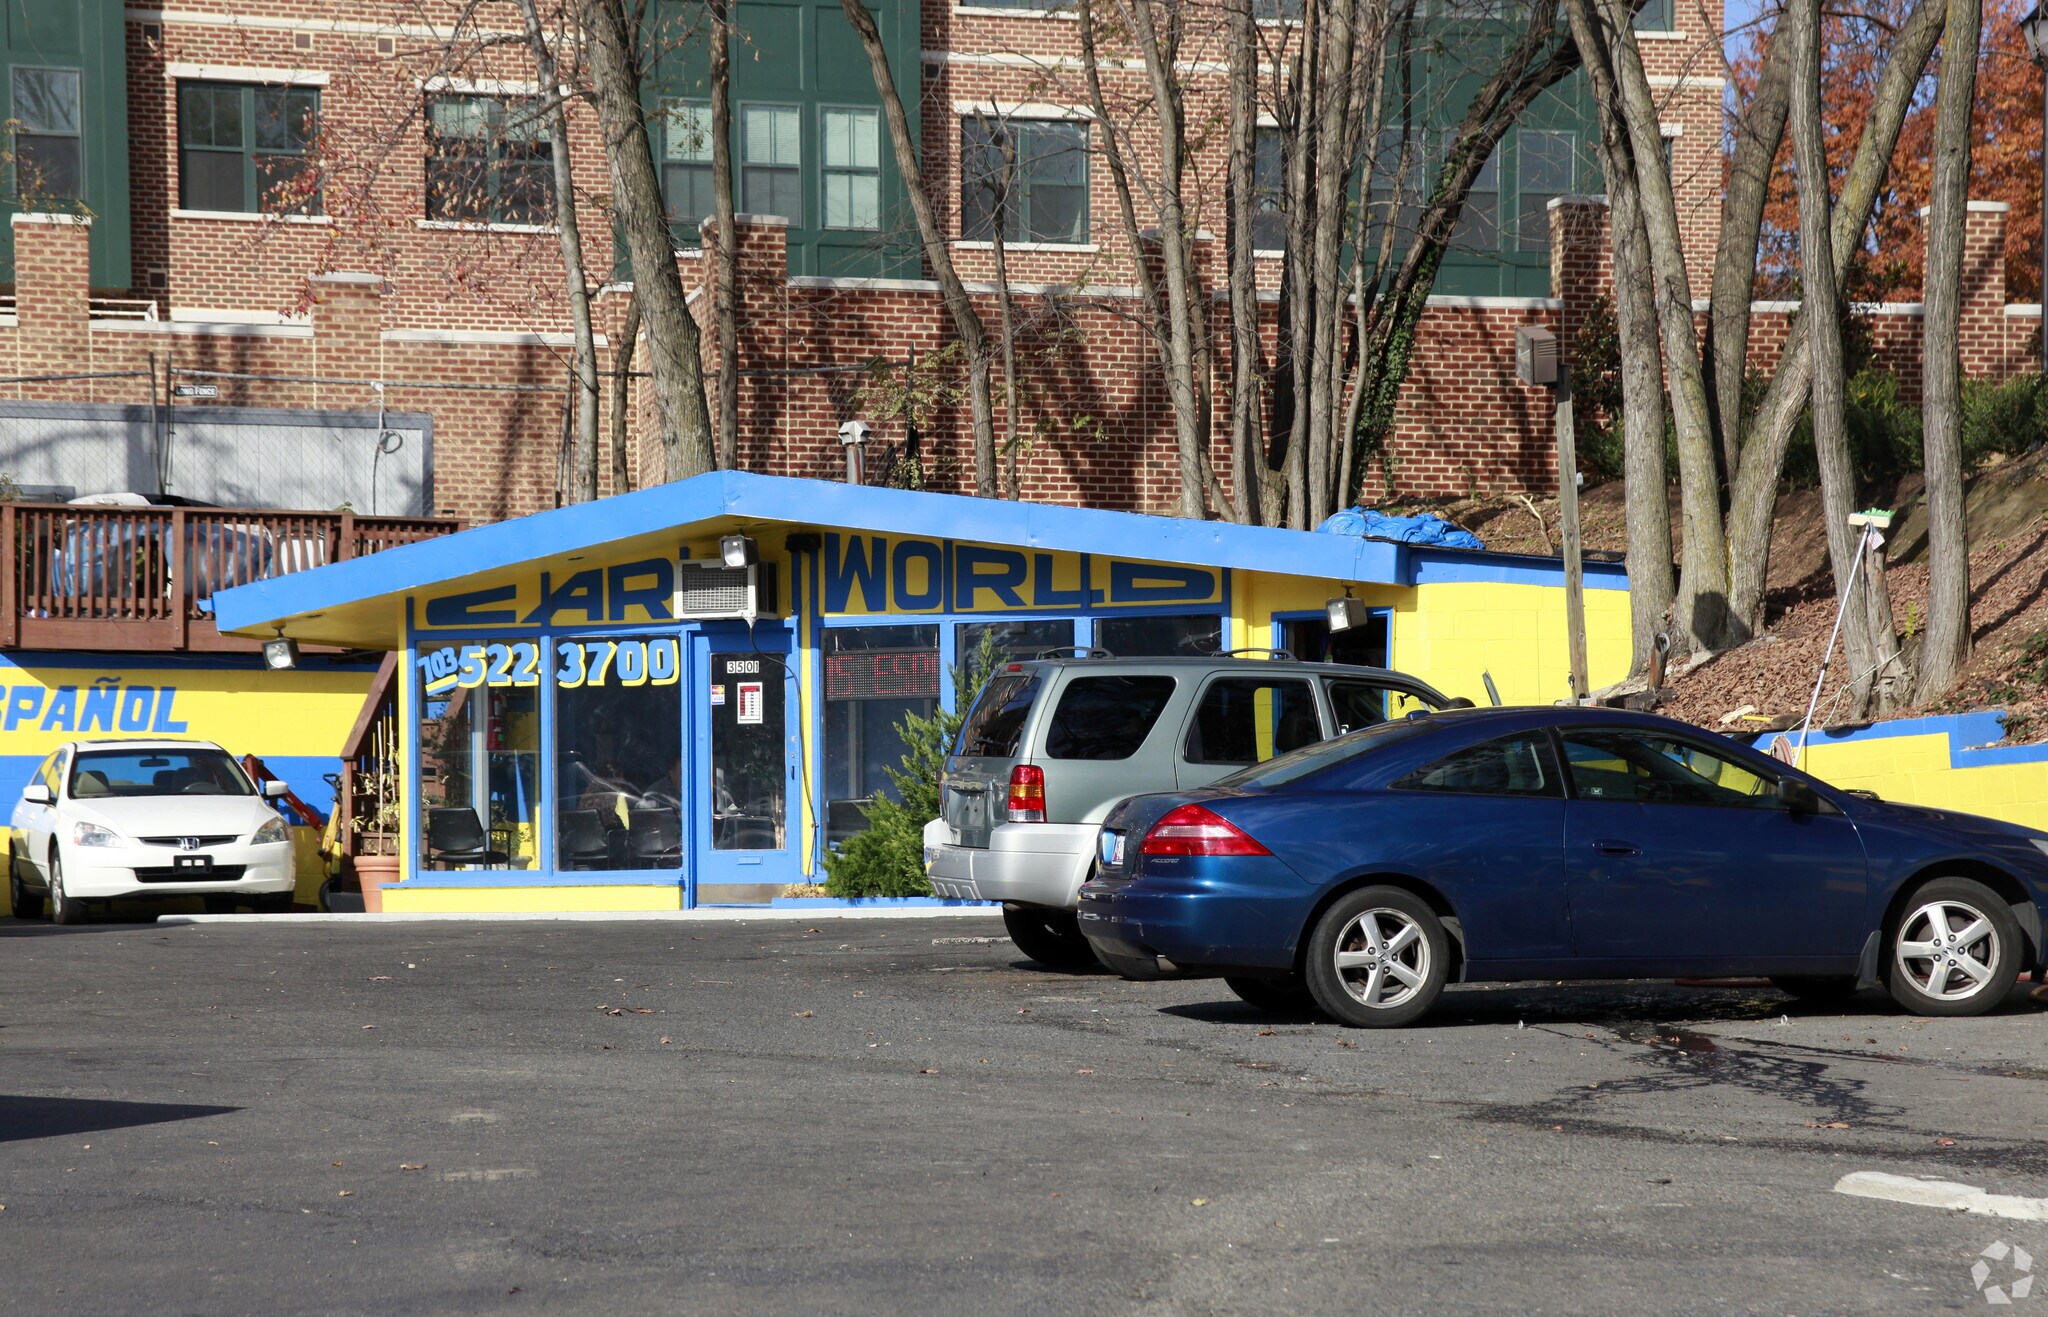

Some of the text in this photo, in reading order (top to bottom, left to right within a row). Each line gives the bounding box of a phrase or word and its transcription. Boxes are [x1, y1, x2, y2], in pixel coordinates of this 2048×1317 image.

[425, 532, 1216, 626] CAR WORLD
[416, 646, 459, 684] 703
[556, 638, 680, 689] 3700
[727, 661, 760, 674] 3501
